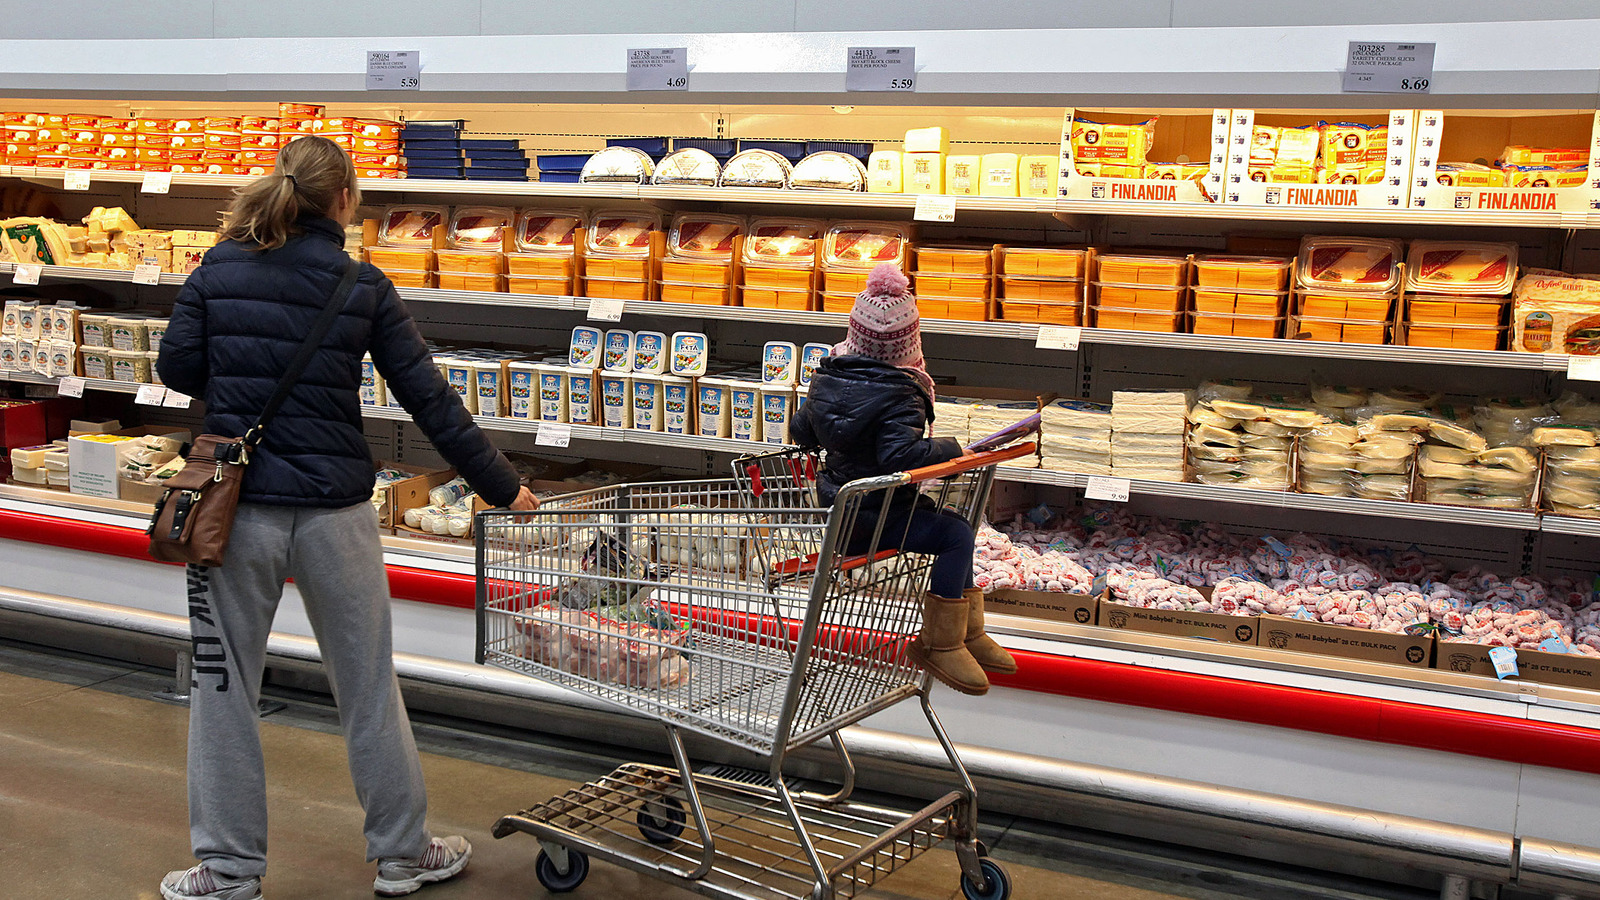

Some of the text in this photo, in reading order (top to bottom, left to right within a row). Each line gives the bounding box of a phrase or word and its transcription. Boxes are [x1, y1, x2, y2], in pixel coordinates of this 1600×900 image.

[401, 79, 418, 87] 5.59
[667, 78, 686, 87] 4.69
[891, 79, 913, 89] 5.59
[1401, 79, 1429, 90] 8.69
[1112, 183, 1176, 201] FINLANDIA
[1287, 188, 1358, 206] FINLANDIA
[1478, 193, 1557, 210] FINLANDIA
[994, 598, 1017, 606] Babybel
[1149, 614, 1173, 623] Babybel
[1312, 635, 1339, 644] Babybel
[1573, 669, 1592, 677] PACK
